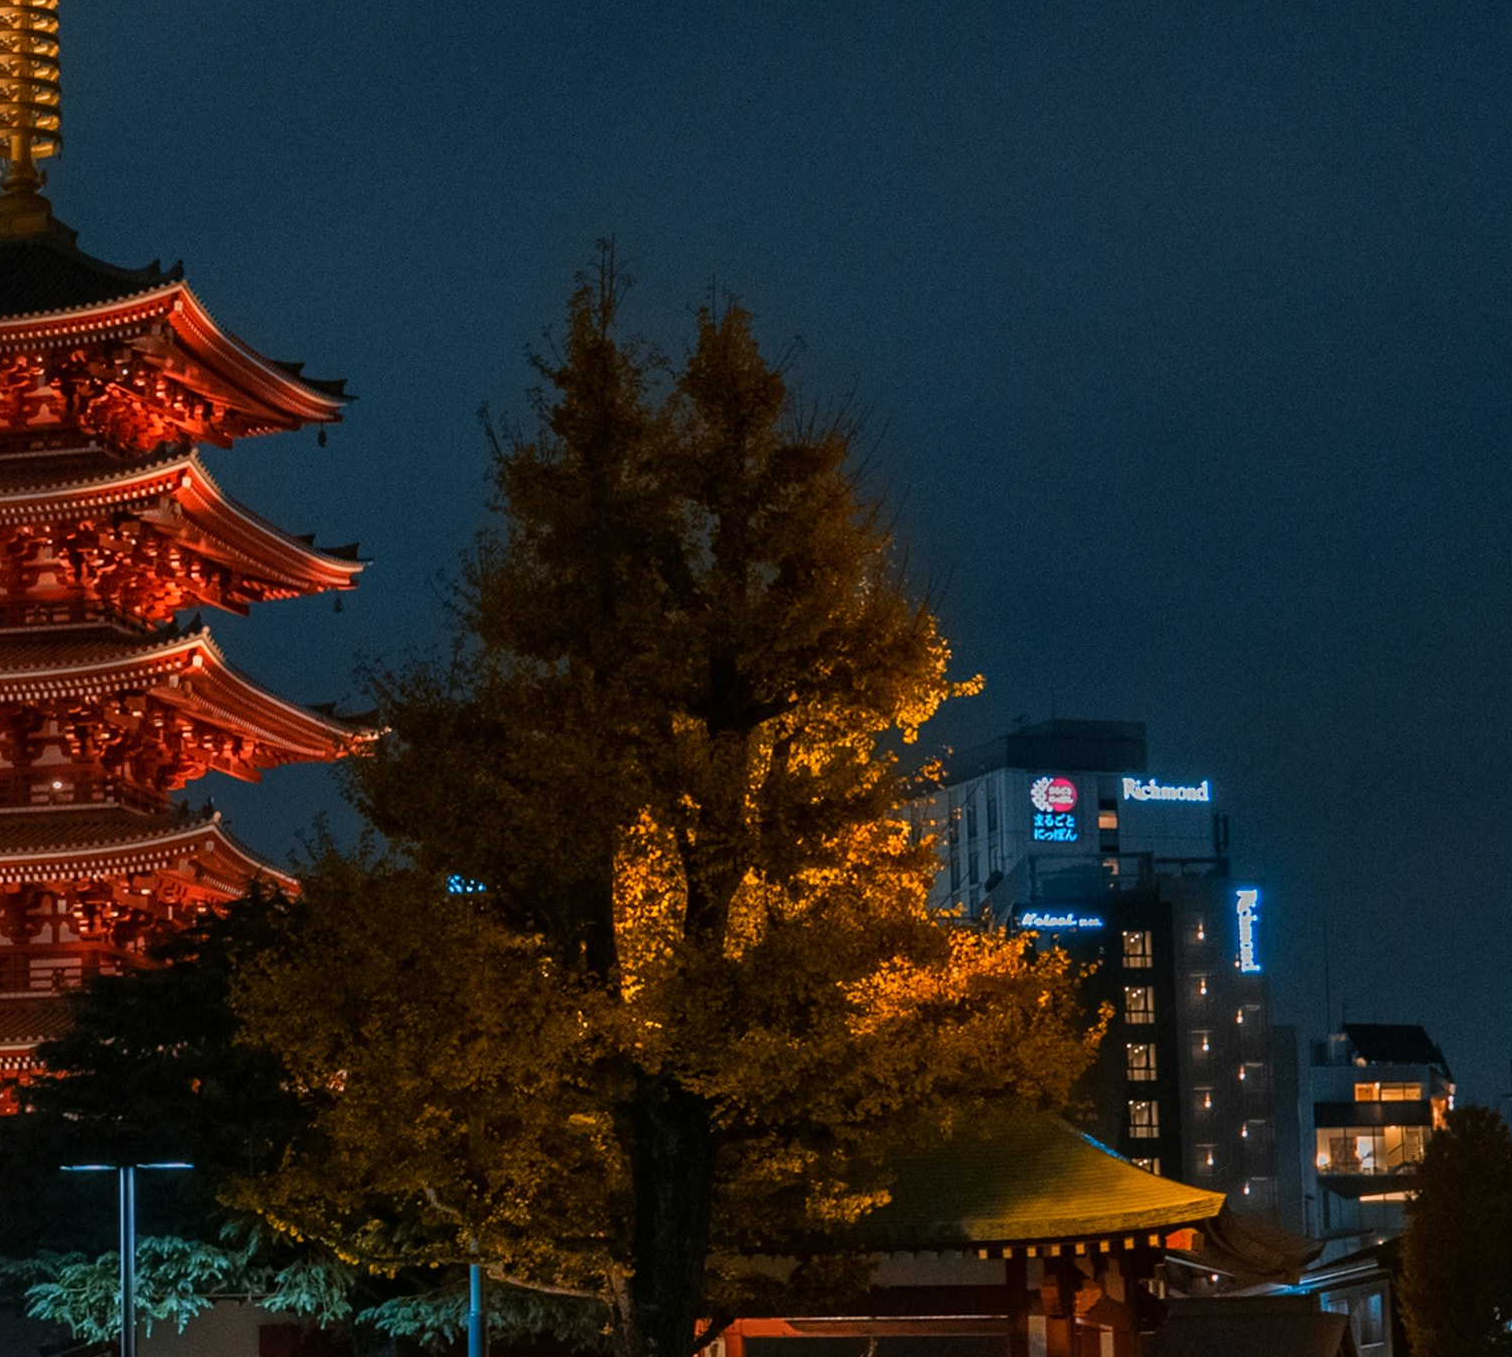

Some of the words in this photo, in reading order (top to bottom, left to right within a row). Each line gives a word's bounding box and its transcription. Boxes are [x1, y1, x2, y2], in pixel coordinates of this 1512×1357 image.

[1122, 777, 1210, 801] Richmond
[1033, 813, 1075, 827] まるごと
[1033, 828, 1078, 842] にっぽん
[1236, 889, 1261, 972] Richmond
